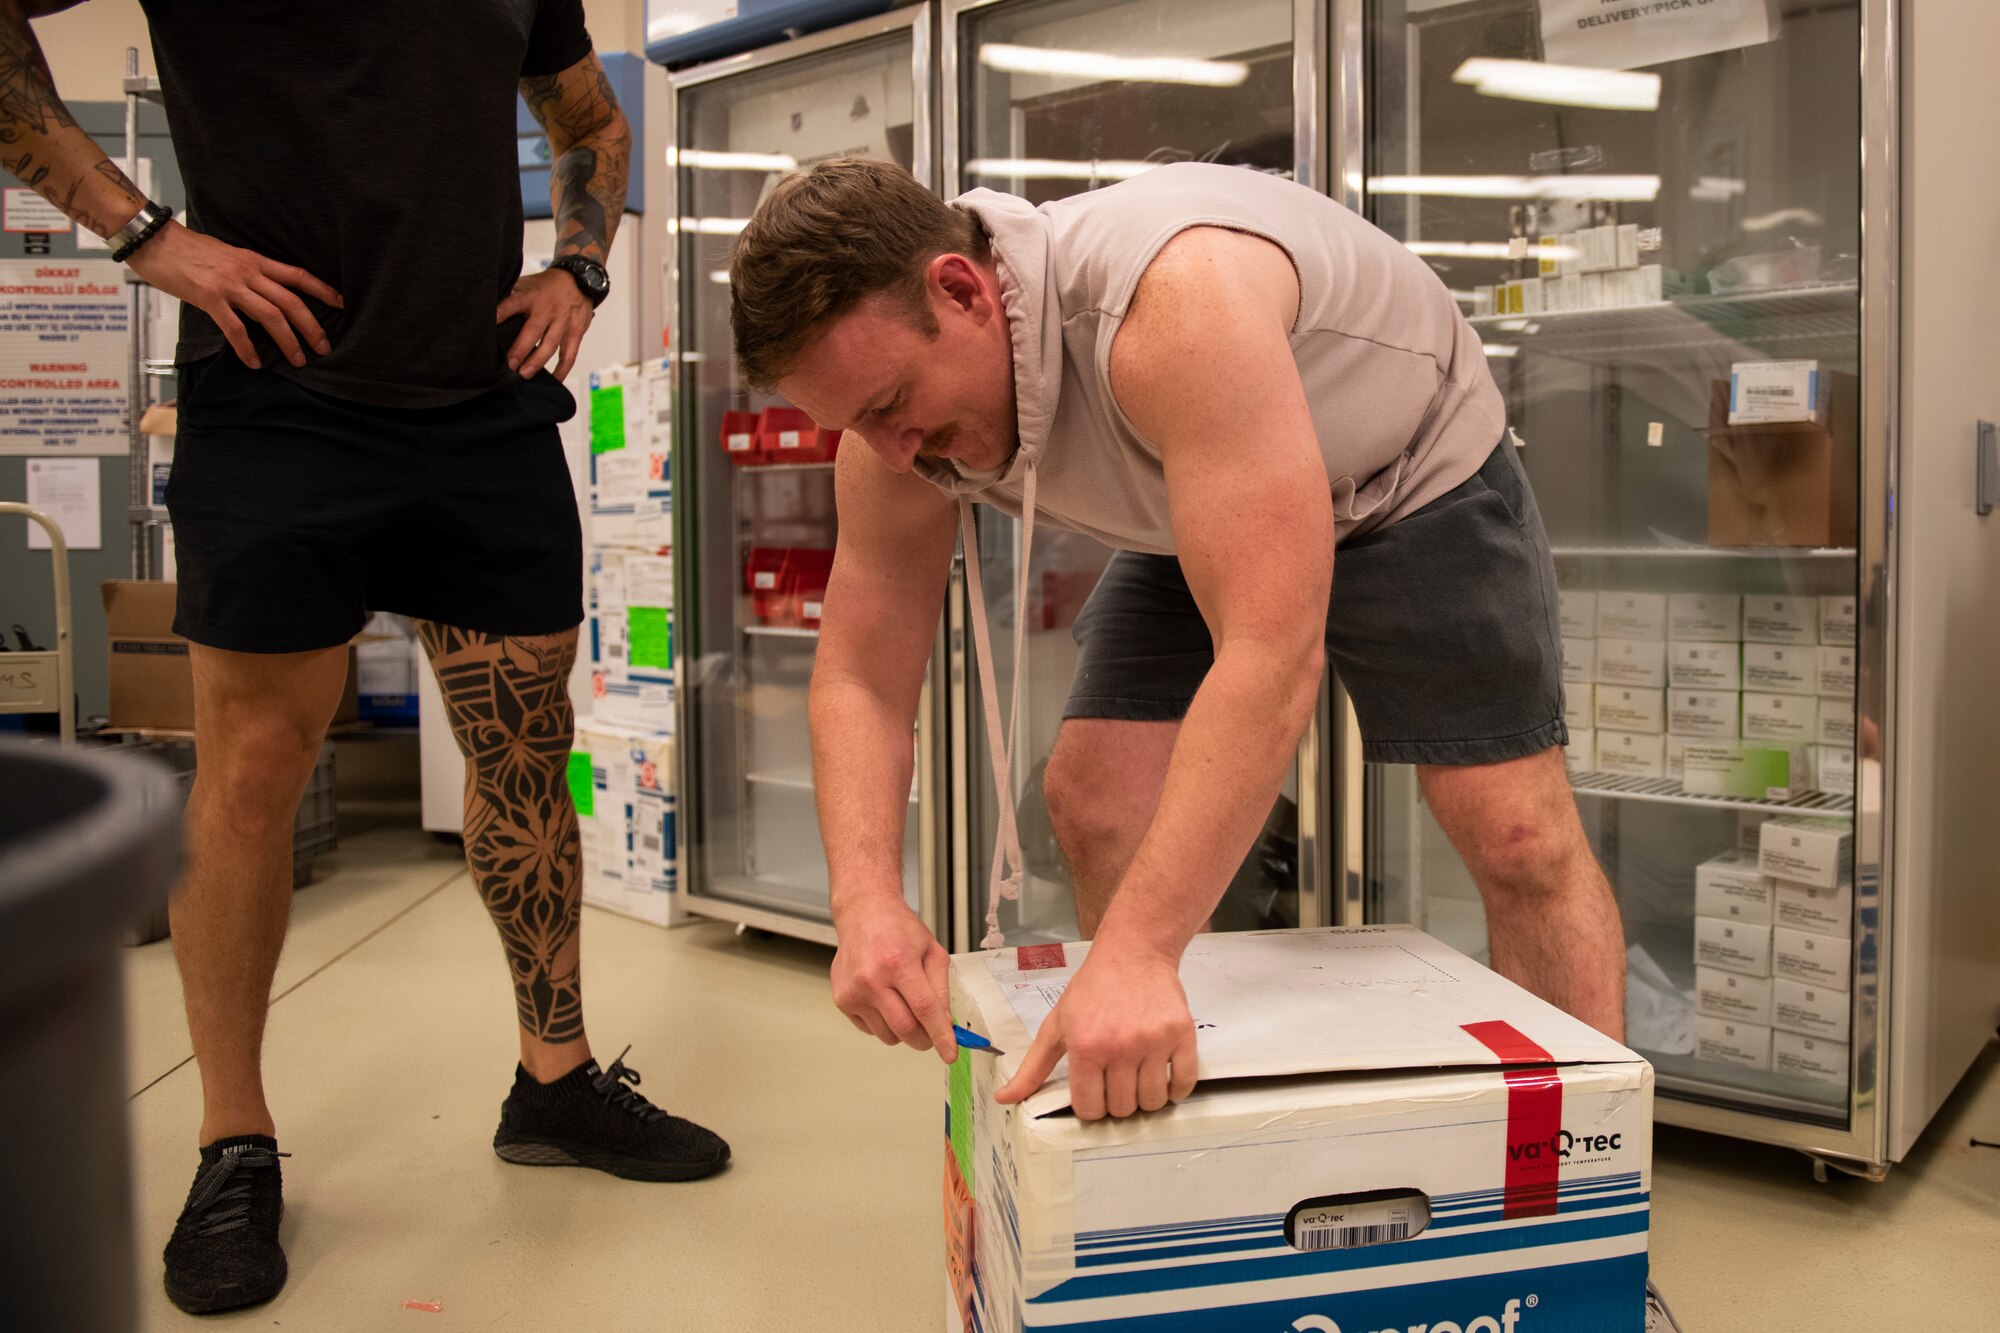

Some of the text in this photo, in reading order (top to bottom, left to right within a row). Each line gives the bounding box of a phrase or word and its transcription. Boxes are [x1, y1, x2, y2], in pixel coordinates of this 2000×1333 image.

[35, 266, 81, 278] DİKKAT
[77, 283, 120, 296] BÖLGE
[29, 362, 88, 373] WARNING
[0, 378, 120, 390] CONTROLLED AREA
[1573, 1156, 1611, 1165] TEMPERATURE
